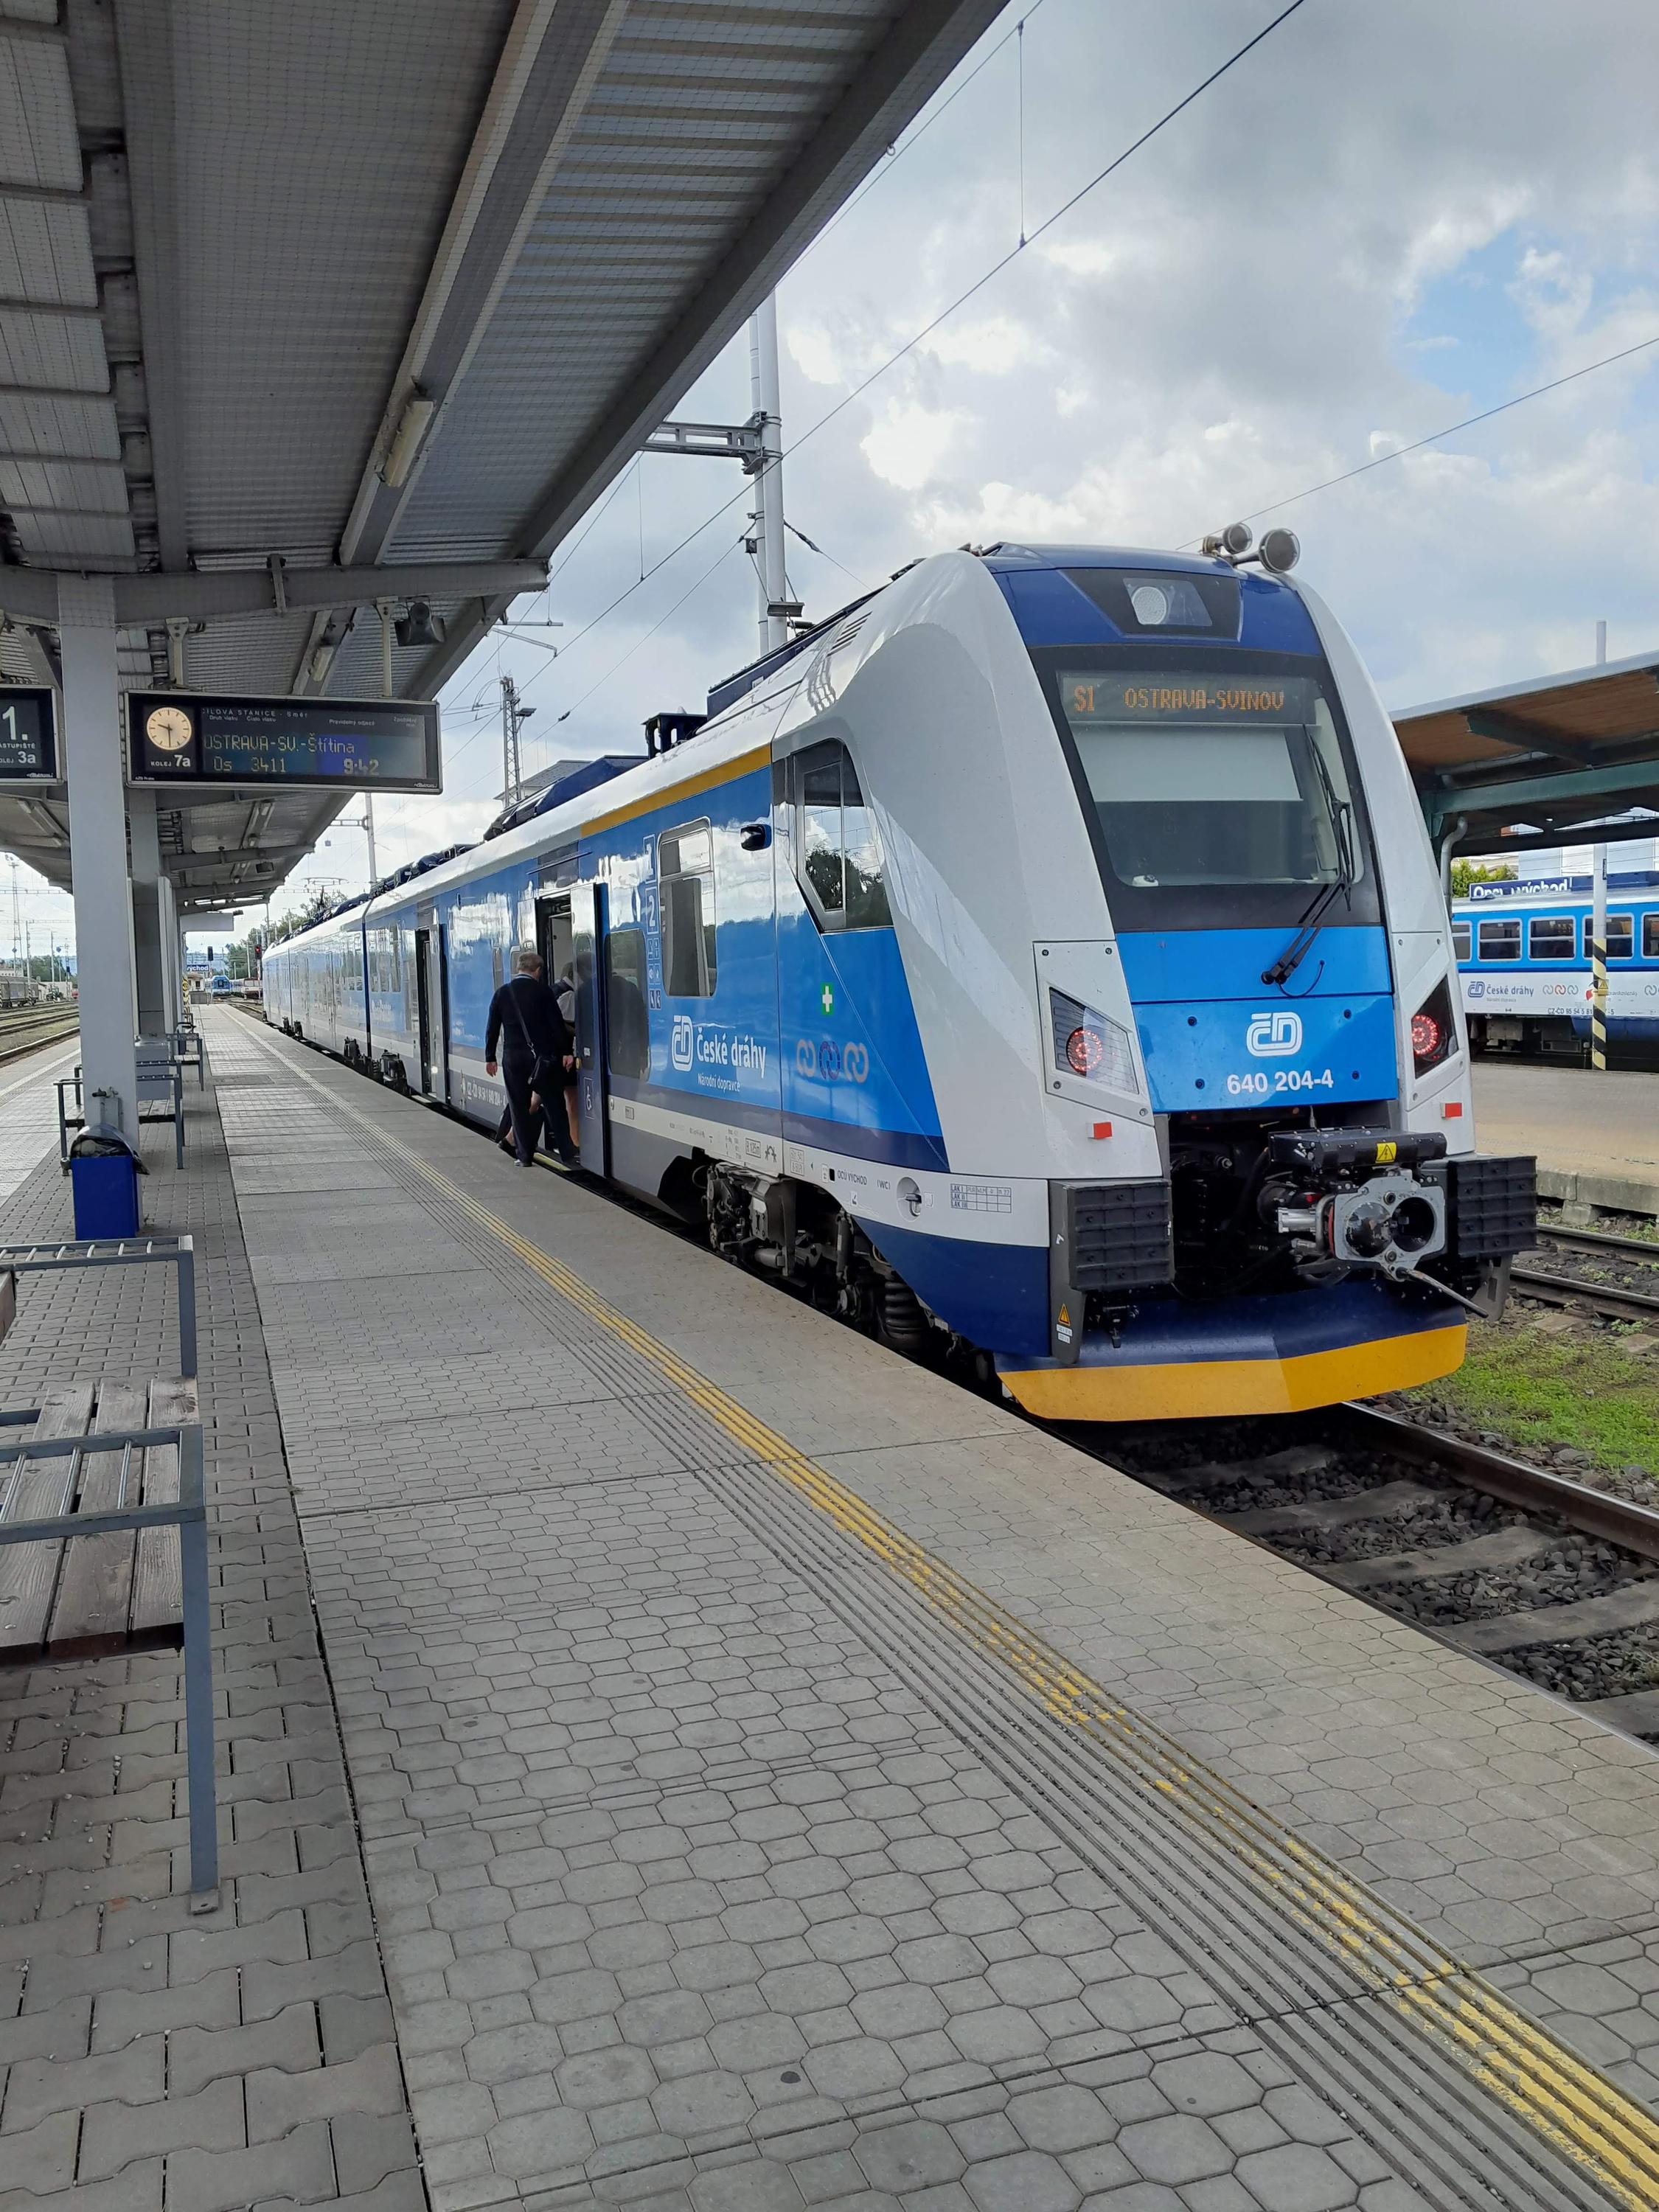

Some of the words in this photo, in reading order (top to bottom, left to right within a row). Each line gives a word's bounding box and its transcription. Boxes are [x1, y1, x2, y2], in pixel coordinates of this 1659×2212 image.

[1074, 685, 1095, 712] S1
[1124, 687, 1284, 711] OSTRAVA-SVINOV
[2, 706, 28, 740] 1.
[18, 751, 36, 763] 3a
[174, 754, 191, 768] 7a
[251, 757, 286, 772] 3411
[1486, 984, 1509, 995] České
[1511, 984, 1534, 997] dráhy
[696, 1026, 728, 1065] České
[731, 1034, 766, 1079] dráhy
[717, 1075, 741, 1093] dopravce
[1227, 1072, 1268, 1095] 640
[1274, 1068, 1334, 1091] 204-4
